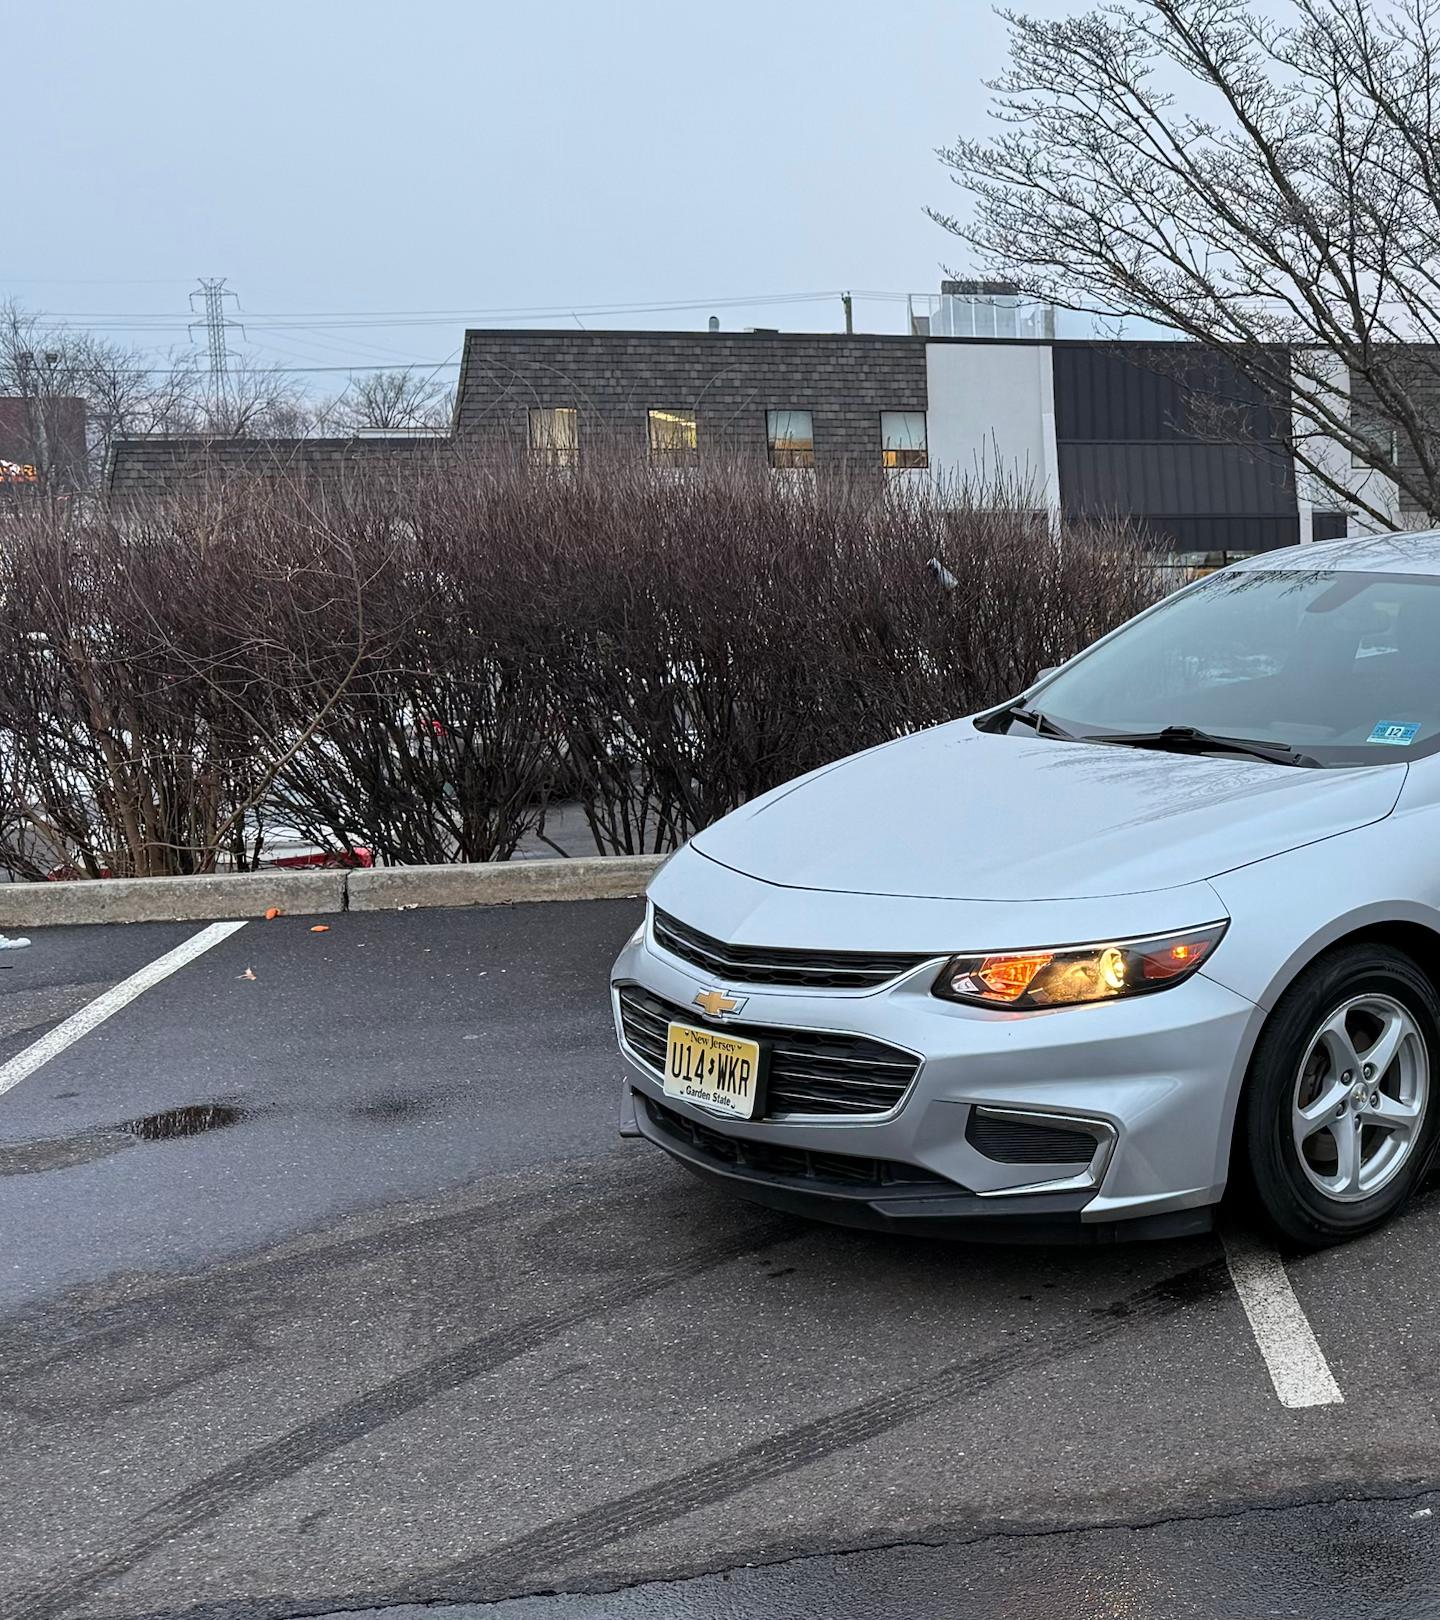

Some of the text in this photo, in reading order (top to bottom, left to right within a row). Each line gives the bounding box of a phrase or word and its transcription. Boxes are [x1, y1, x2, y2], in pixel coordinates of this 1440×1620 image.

[1388, 728, 1402, 736] 12
[690, 1030, 736, 1053] New Jersey
[671, 1042, 751, 1097] U14 WKR
[686, 1085, 731, 1107] Garden State
